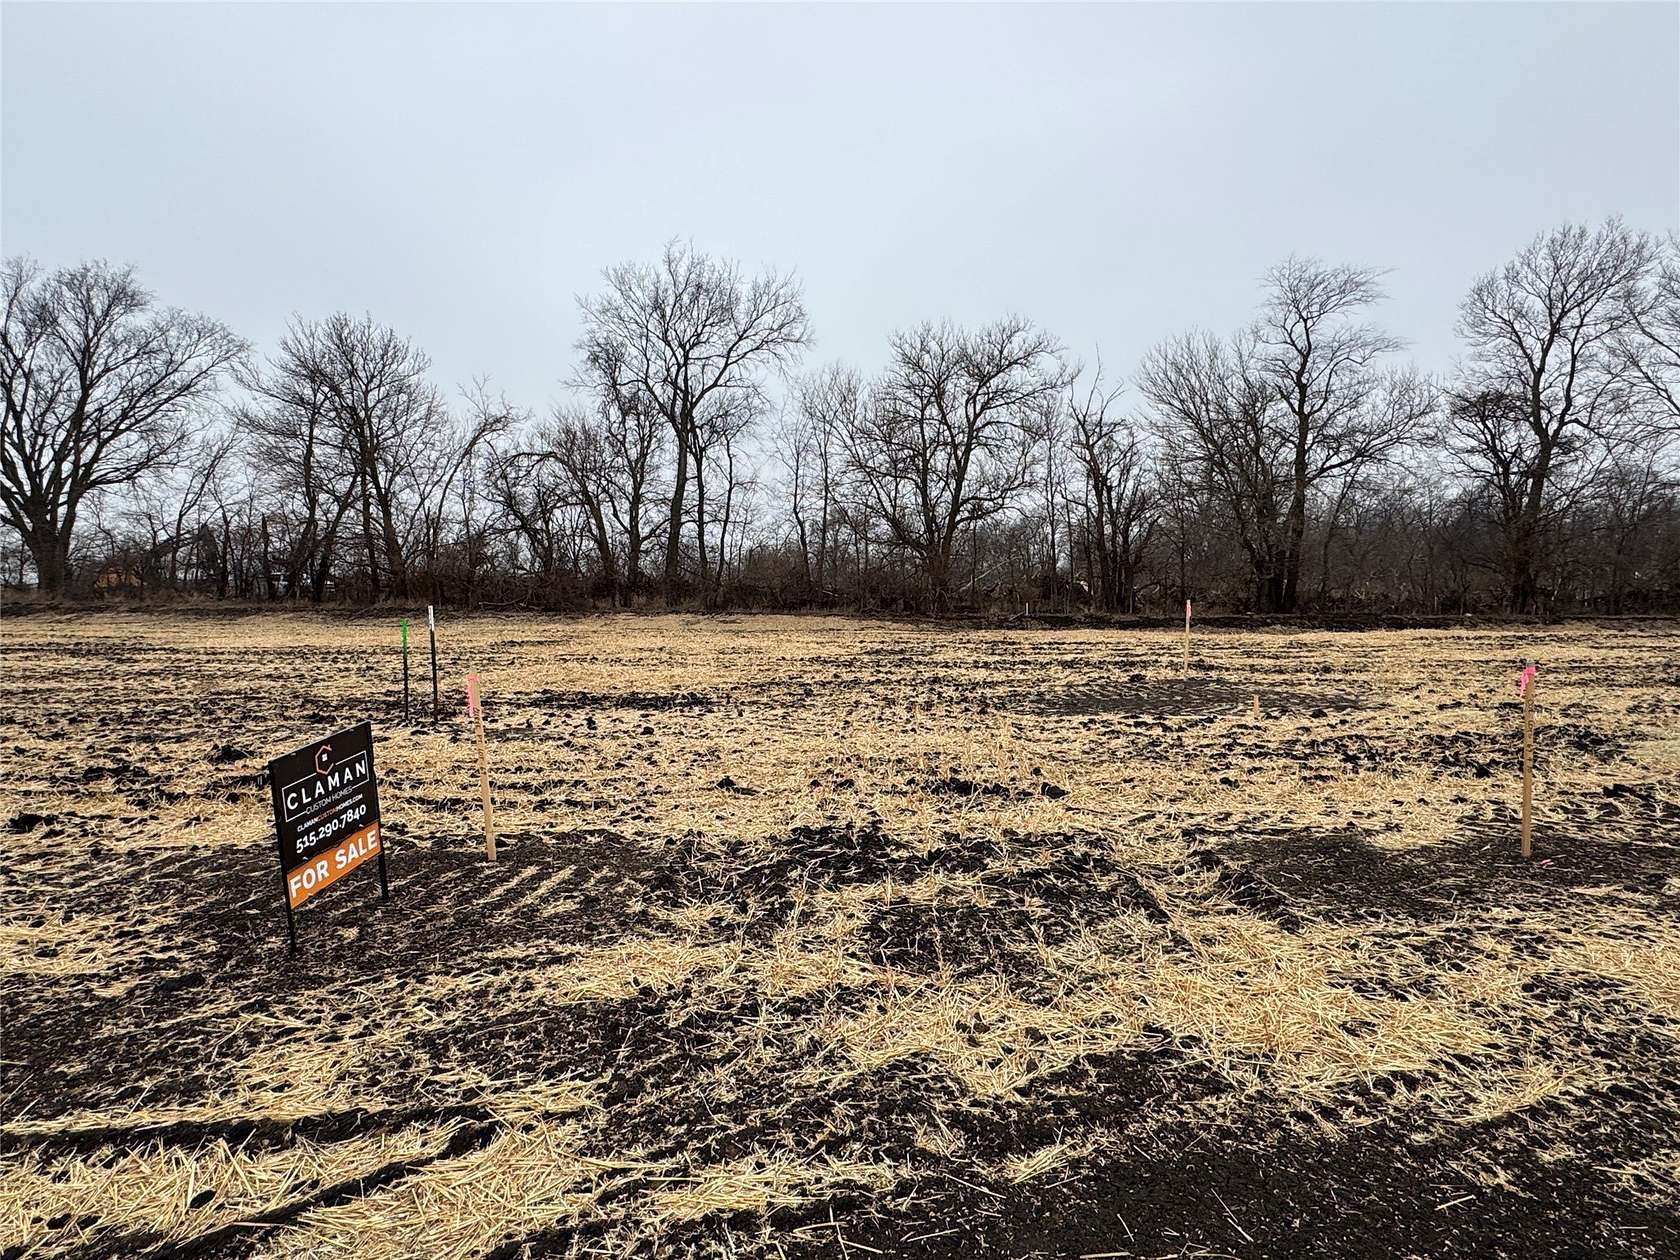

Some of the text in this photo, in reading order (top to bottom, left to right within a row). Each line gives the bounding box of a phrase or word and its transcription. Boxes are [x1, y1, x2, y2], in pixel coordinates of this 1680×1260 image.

[286, 760, 367, 810] CLAMAN
[305, 786, 353, 815] CUSTOM HOMES
[296, 804, 367, 854] 515.290.7840
[297, 794, 363, 832] CLAMANCUSTOMHOMES.COM
[289, 829, 378, 899] FOR SALE
